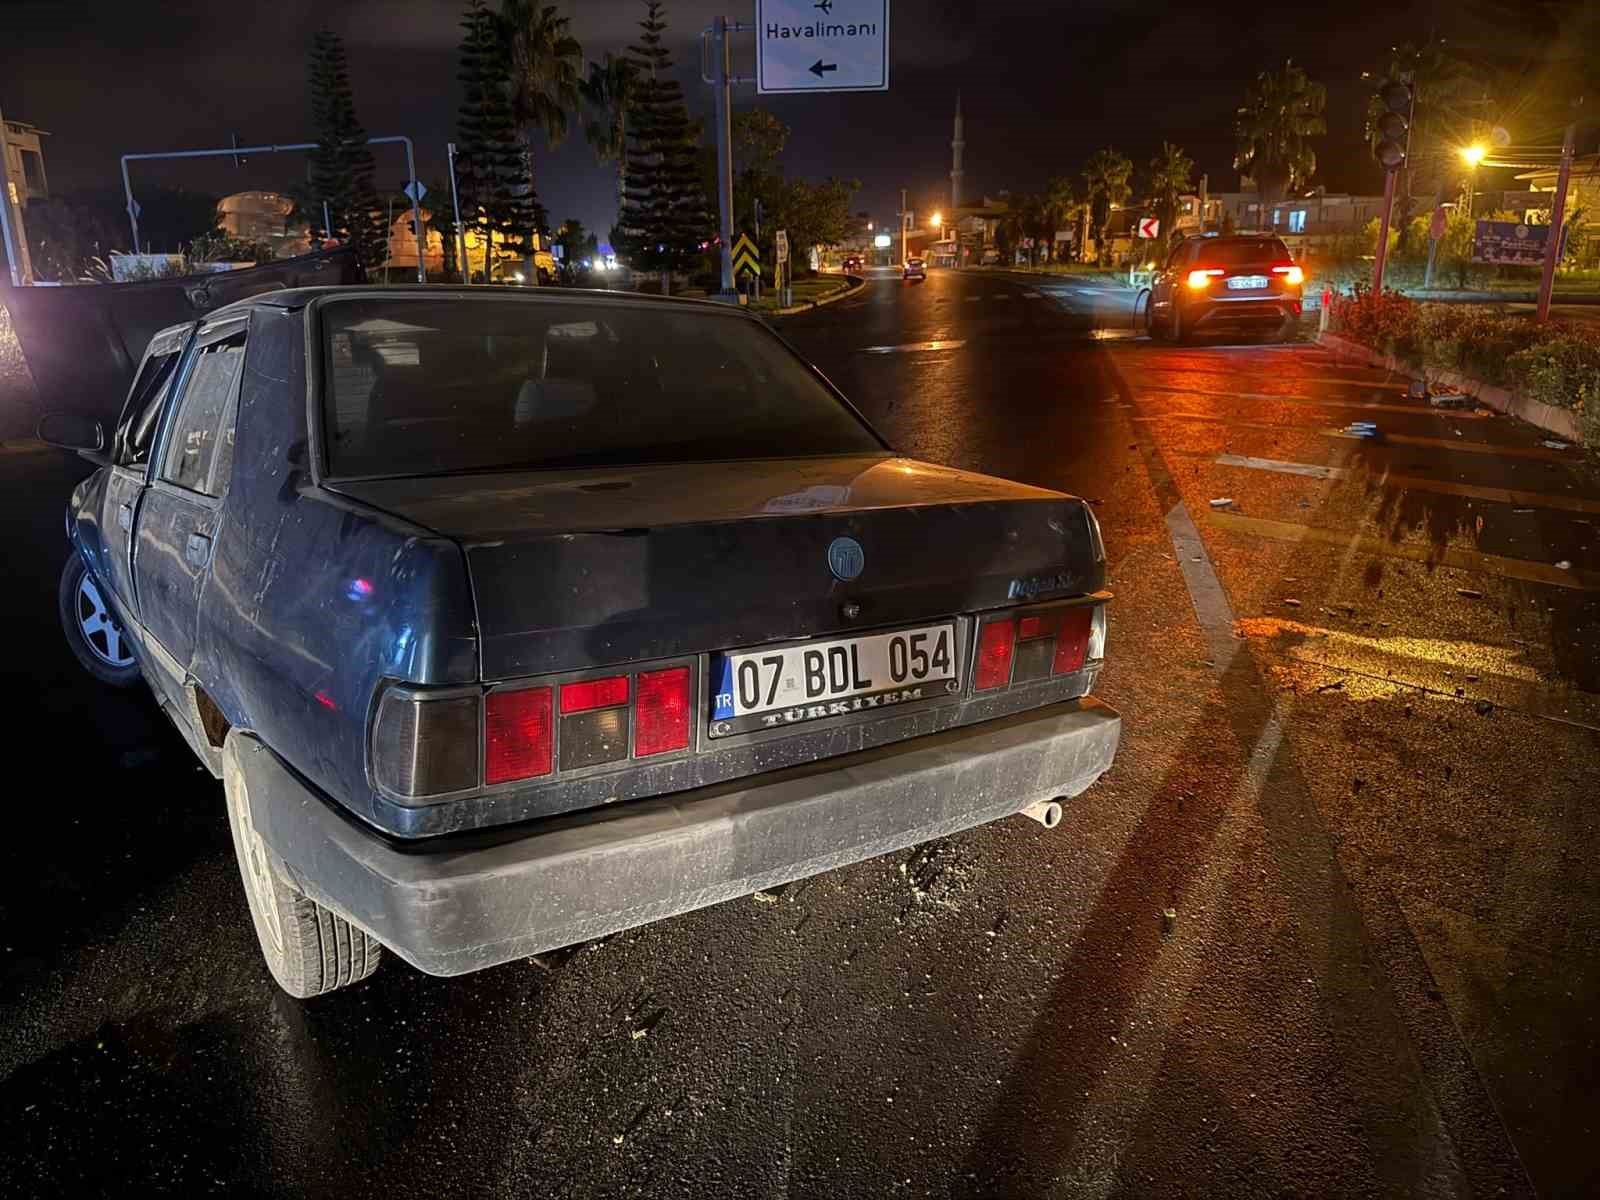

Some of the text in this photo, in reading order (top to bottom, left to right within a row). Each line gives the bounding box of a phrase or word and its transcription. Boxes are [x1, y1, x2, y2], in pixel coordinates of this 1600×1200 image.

[766, 20, 877, 39] Havalimanı
[737, 630, 951, 710] 07 BDL 054
[714, 692, 733, 709] TR
